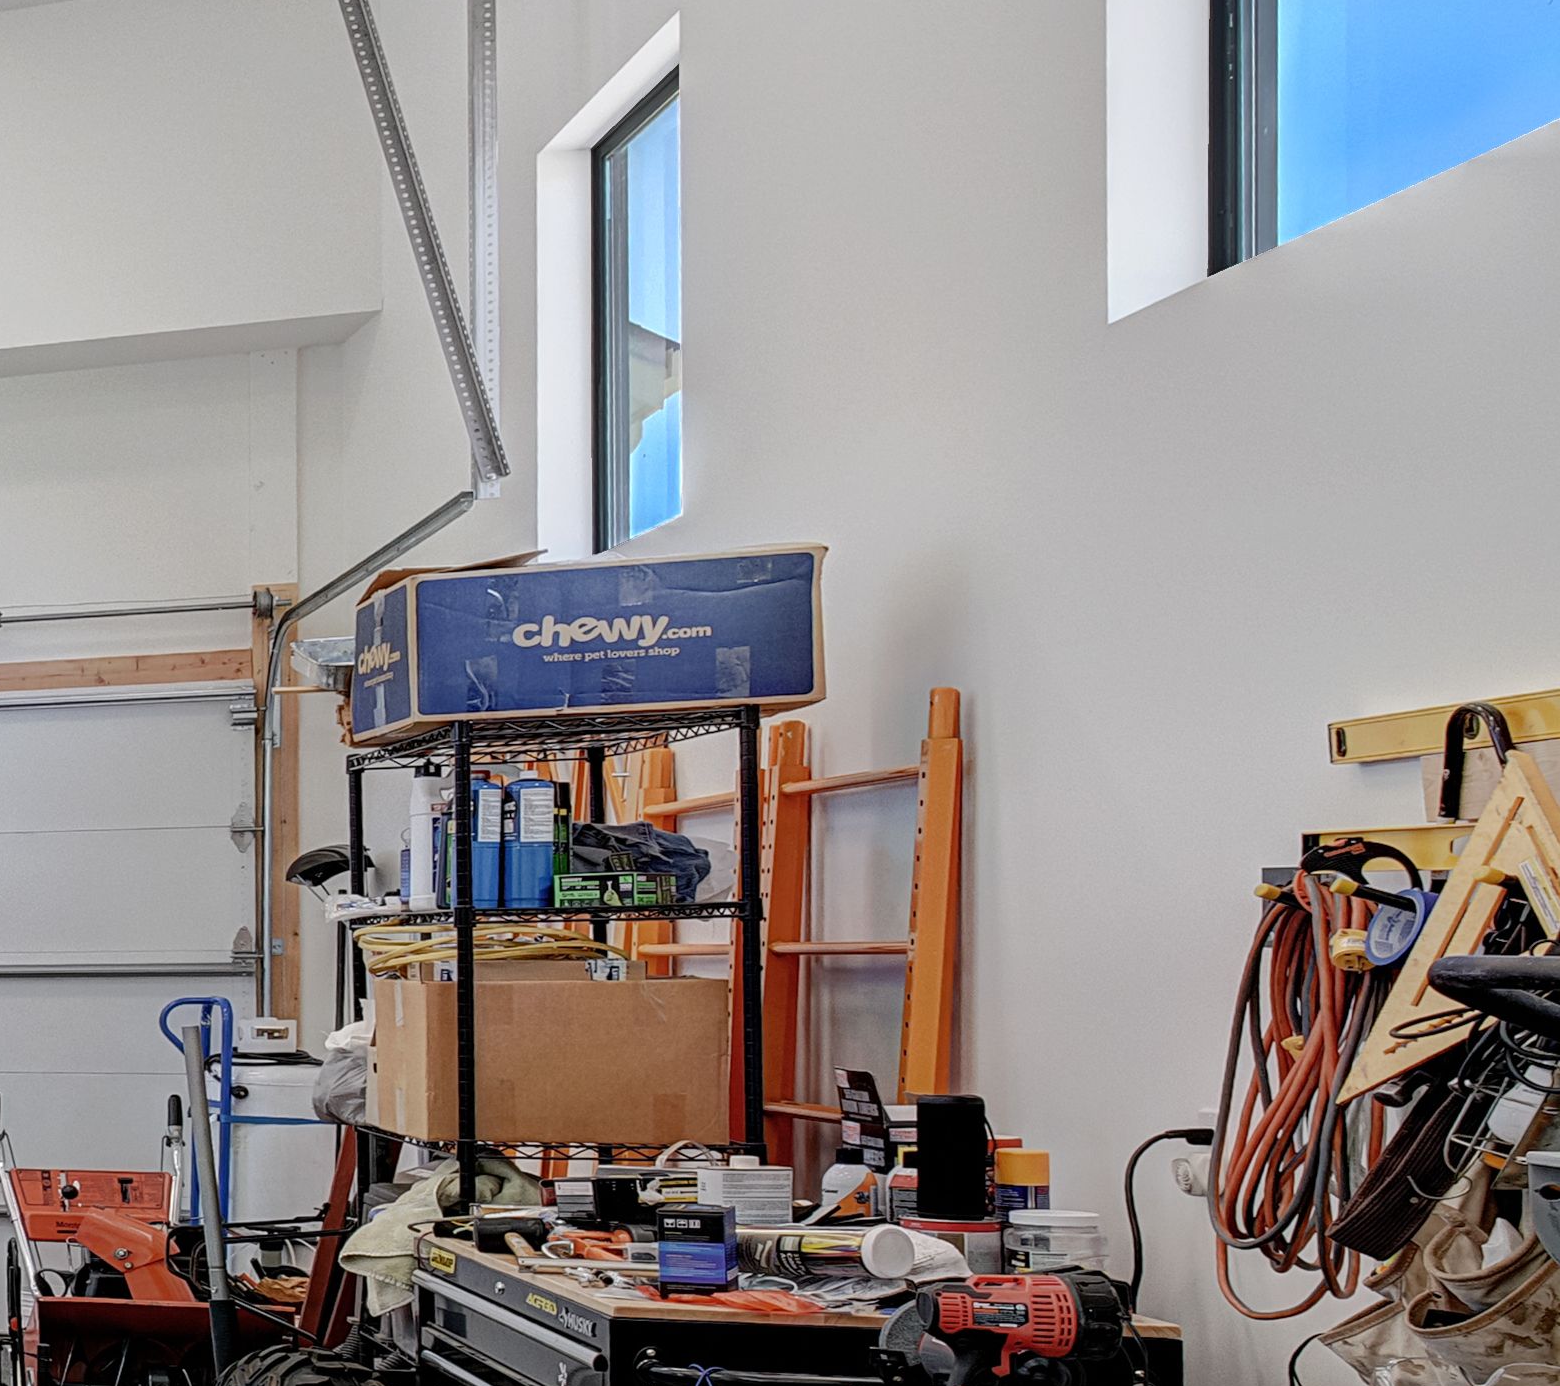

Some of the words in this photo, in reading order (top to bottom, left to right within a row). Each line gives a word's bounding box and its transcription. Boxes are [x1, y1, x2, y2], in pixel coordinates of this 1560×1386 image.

[512, 615, 712, 648] chewy.com
[543, 651, 582, 663] where
[584, 650, 606, 662] pet
[607, 647, 645, 659] lovers
[647, 645, 681, 659] shop
[567, 1312, 594, 1338] HUSKY
